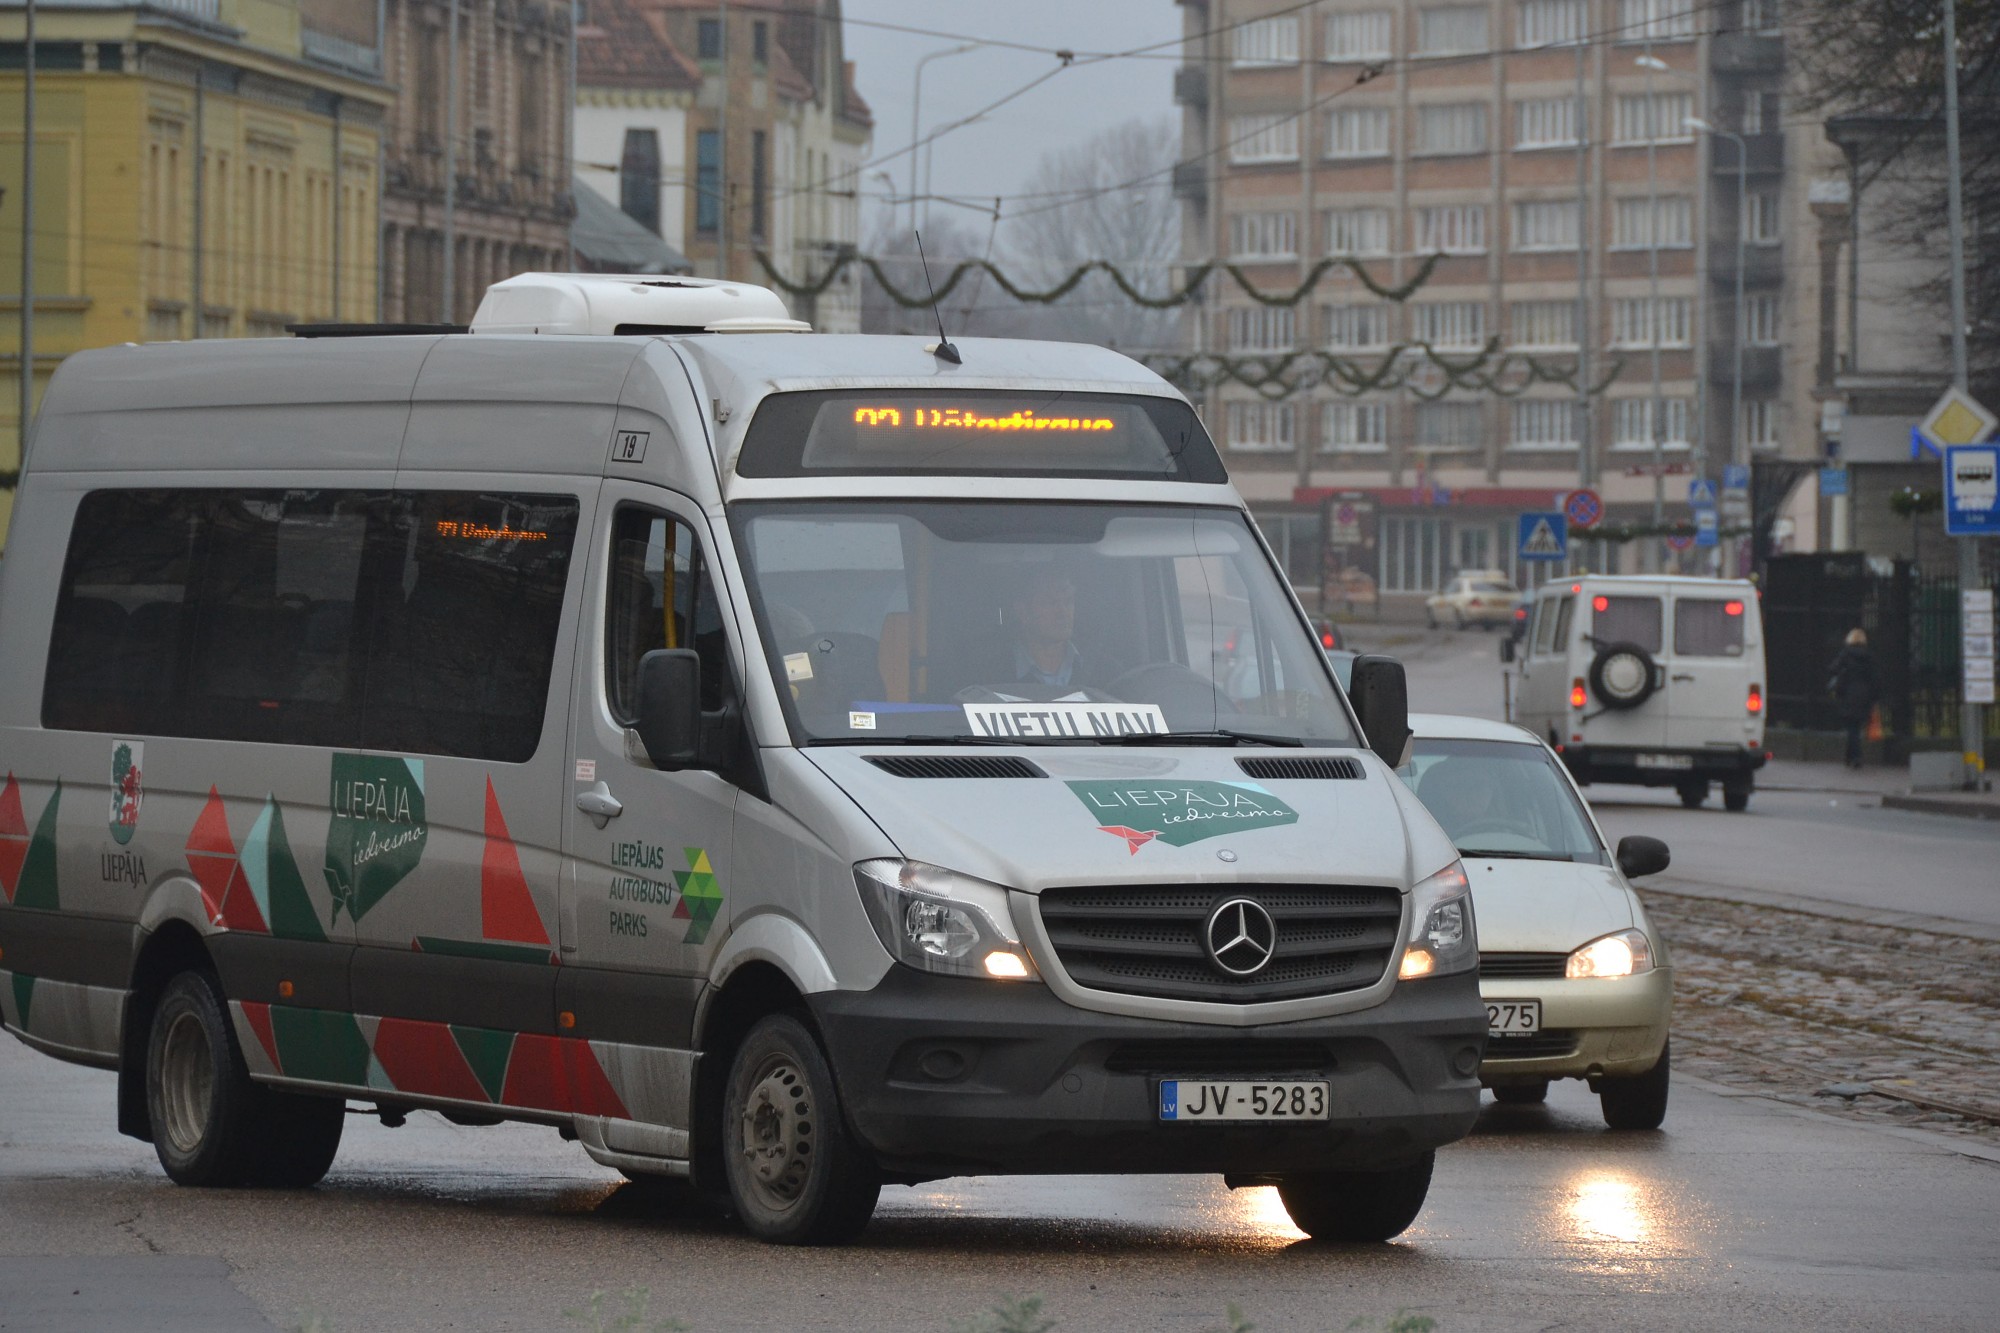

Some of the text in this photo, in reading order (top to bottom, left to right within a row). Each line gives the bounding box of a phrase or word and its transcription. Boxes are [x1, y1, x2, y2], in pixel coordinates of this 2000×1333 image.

[622, 434, 637, 459] 19
[1085, 711, 1157, 736] NAV
[334, 777, 413, 825] LIEPĀJA
[1087, 788, 1263, 809] LIEPĀJA
[611, 840, 665, 870] LIEPĀJAS
[101, 850, 148, 889] LIEPĀJA
[609, 877, 672, 906] AUTOBUSU
[609, 911, 648, 938] PARKS
[1162, 1103, 1176, 1113] LV
[1186, 1085, 1325, 1116] JV-5283
